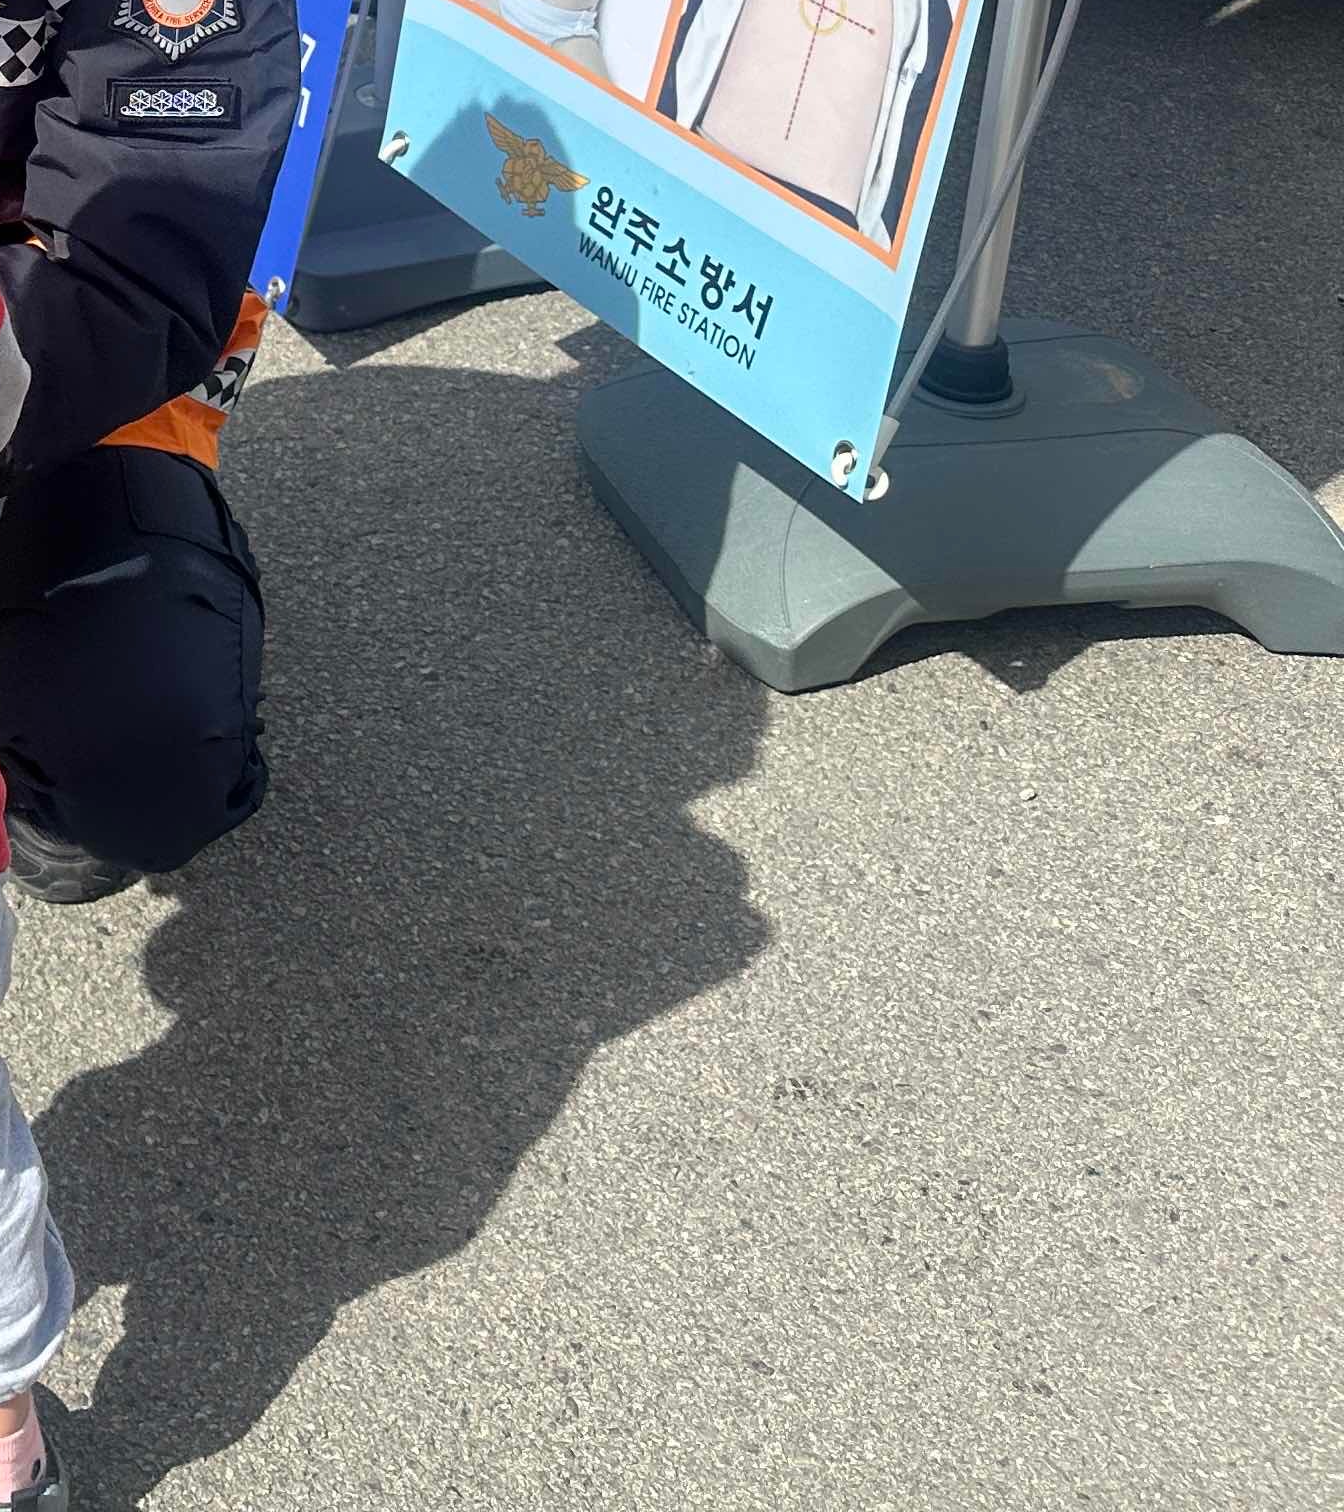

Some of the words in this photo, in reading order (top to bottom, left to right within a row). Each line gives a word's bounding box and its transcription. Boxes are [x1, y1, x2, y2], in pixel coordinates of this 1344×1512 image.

[579, 232, 638, 288] WANJU
[640, 276, 677, 315] FIRE
[677, 303, 755, 370] STATION
[589, 186, 773, 340] 완주소방서
